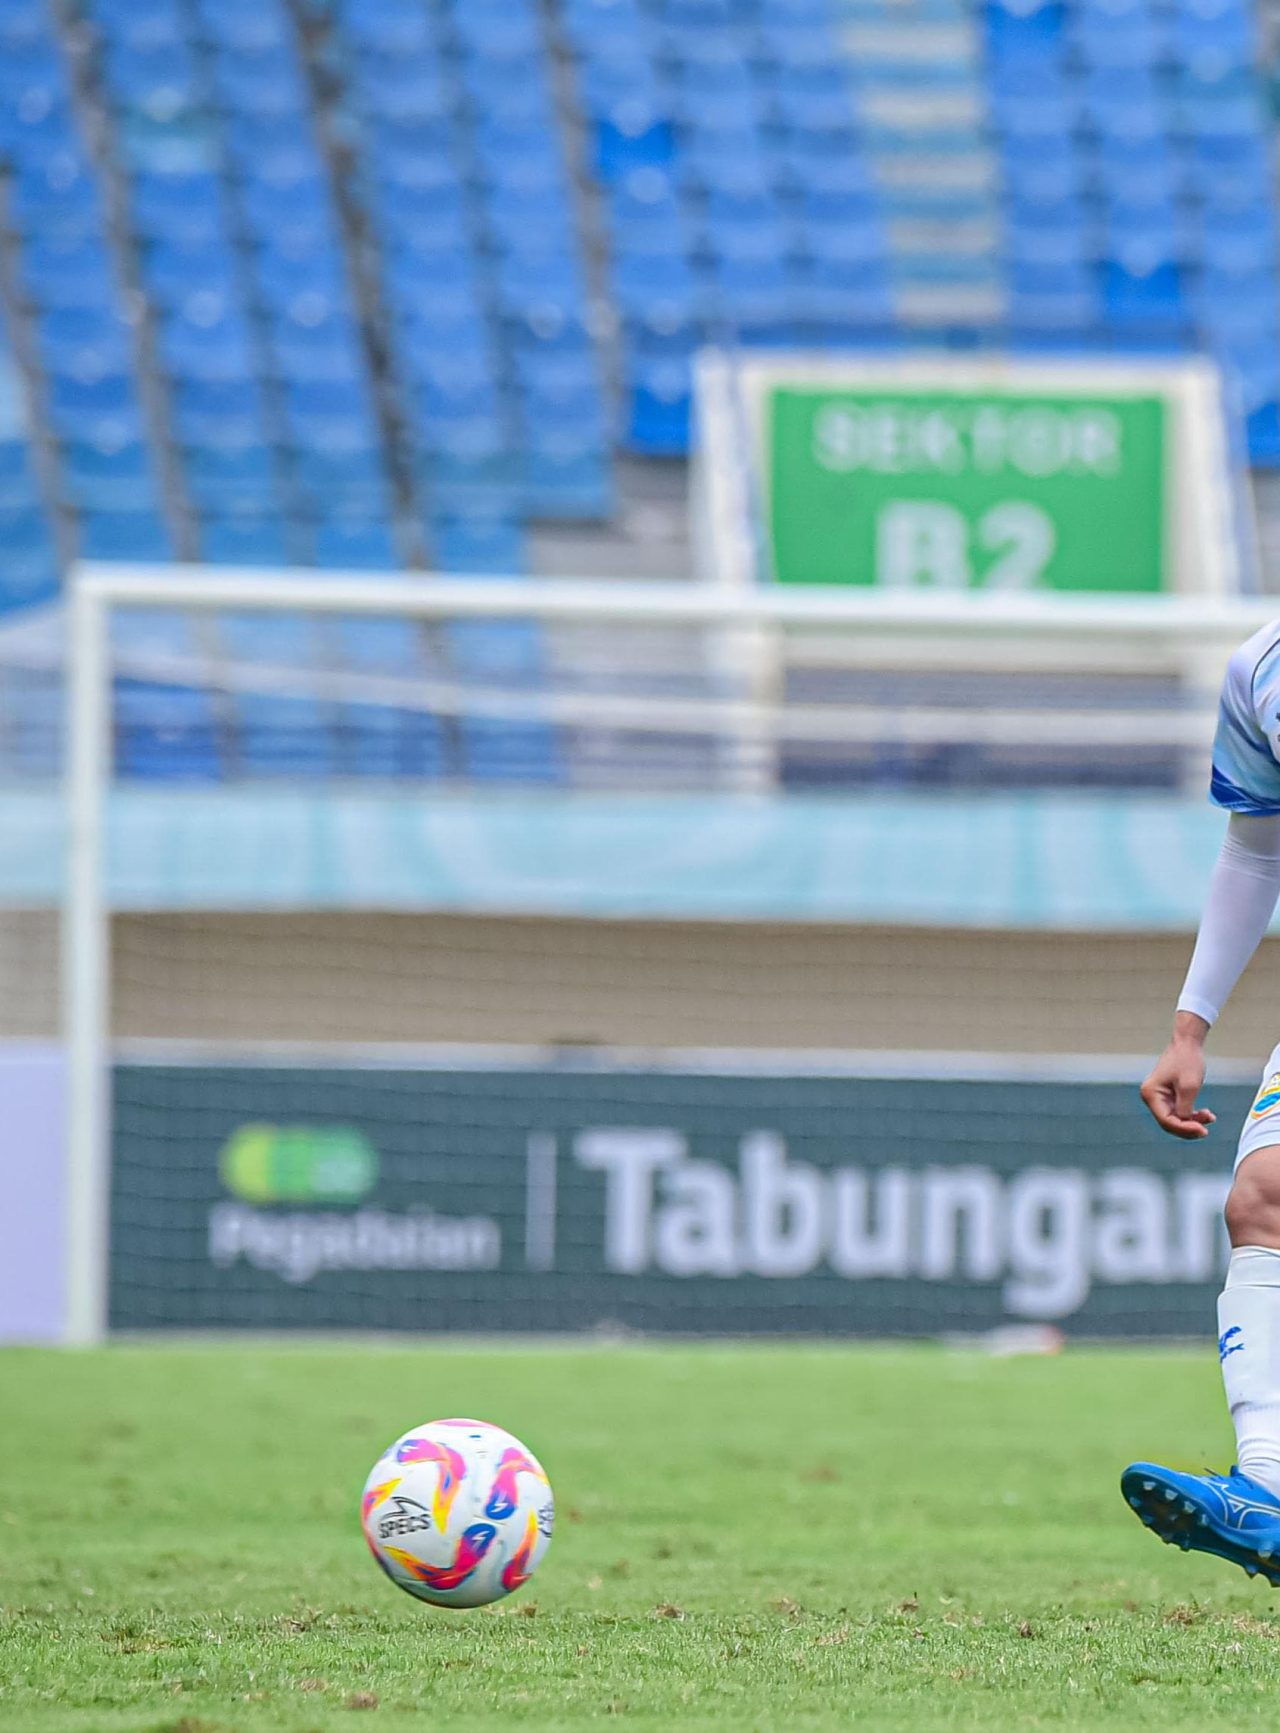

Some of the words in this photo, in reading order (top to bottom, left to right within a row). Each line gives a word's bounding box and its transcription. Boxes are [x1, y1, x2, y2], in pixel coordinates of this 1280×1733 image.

[812, 402, 1122, 477] SEKTOR
[874, 500, 1056, 589] B2
[379, 1513, 431, 1539] SPECS
